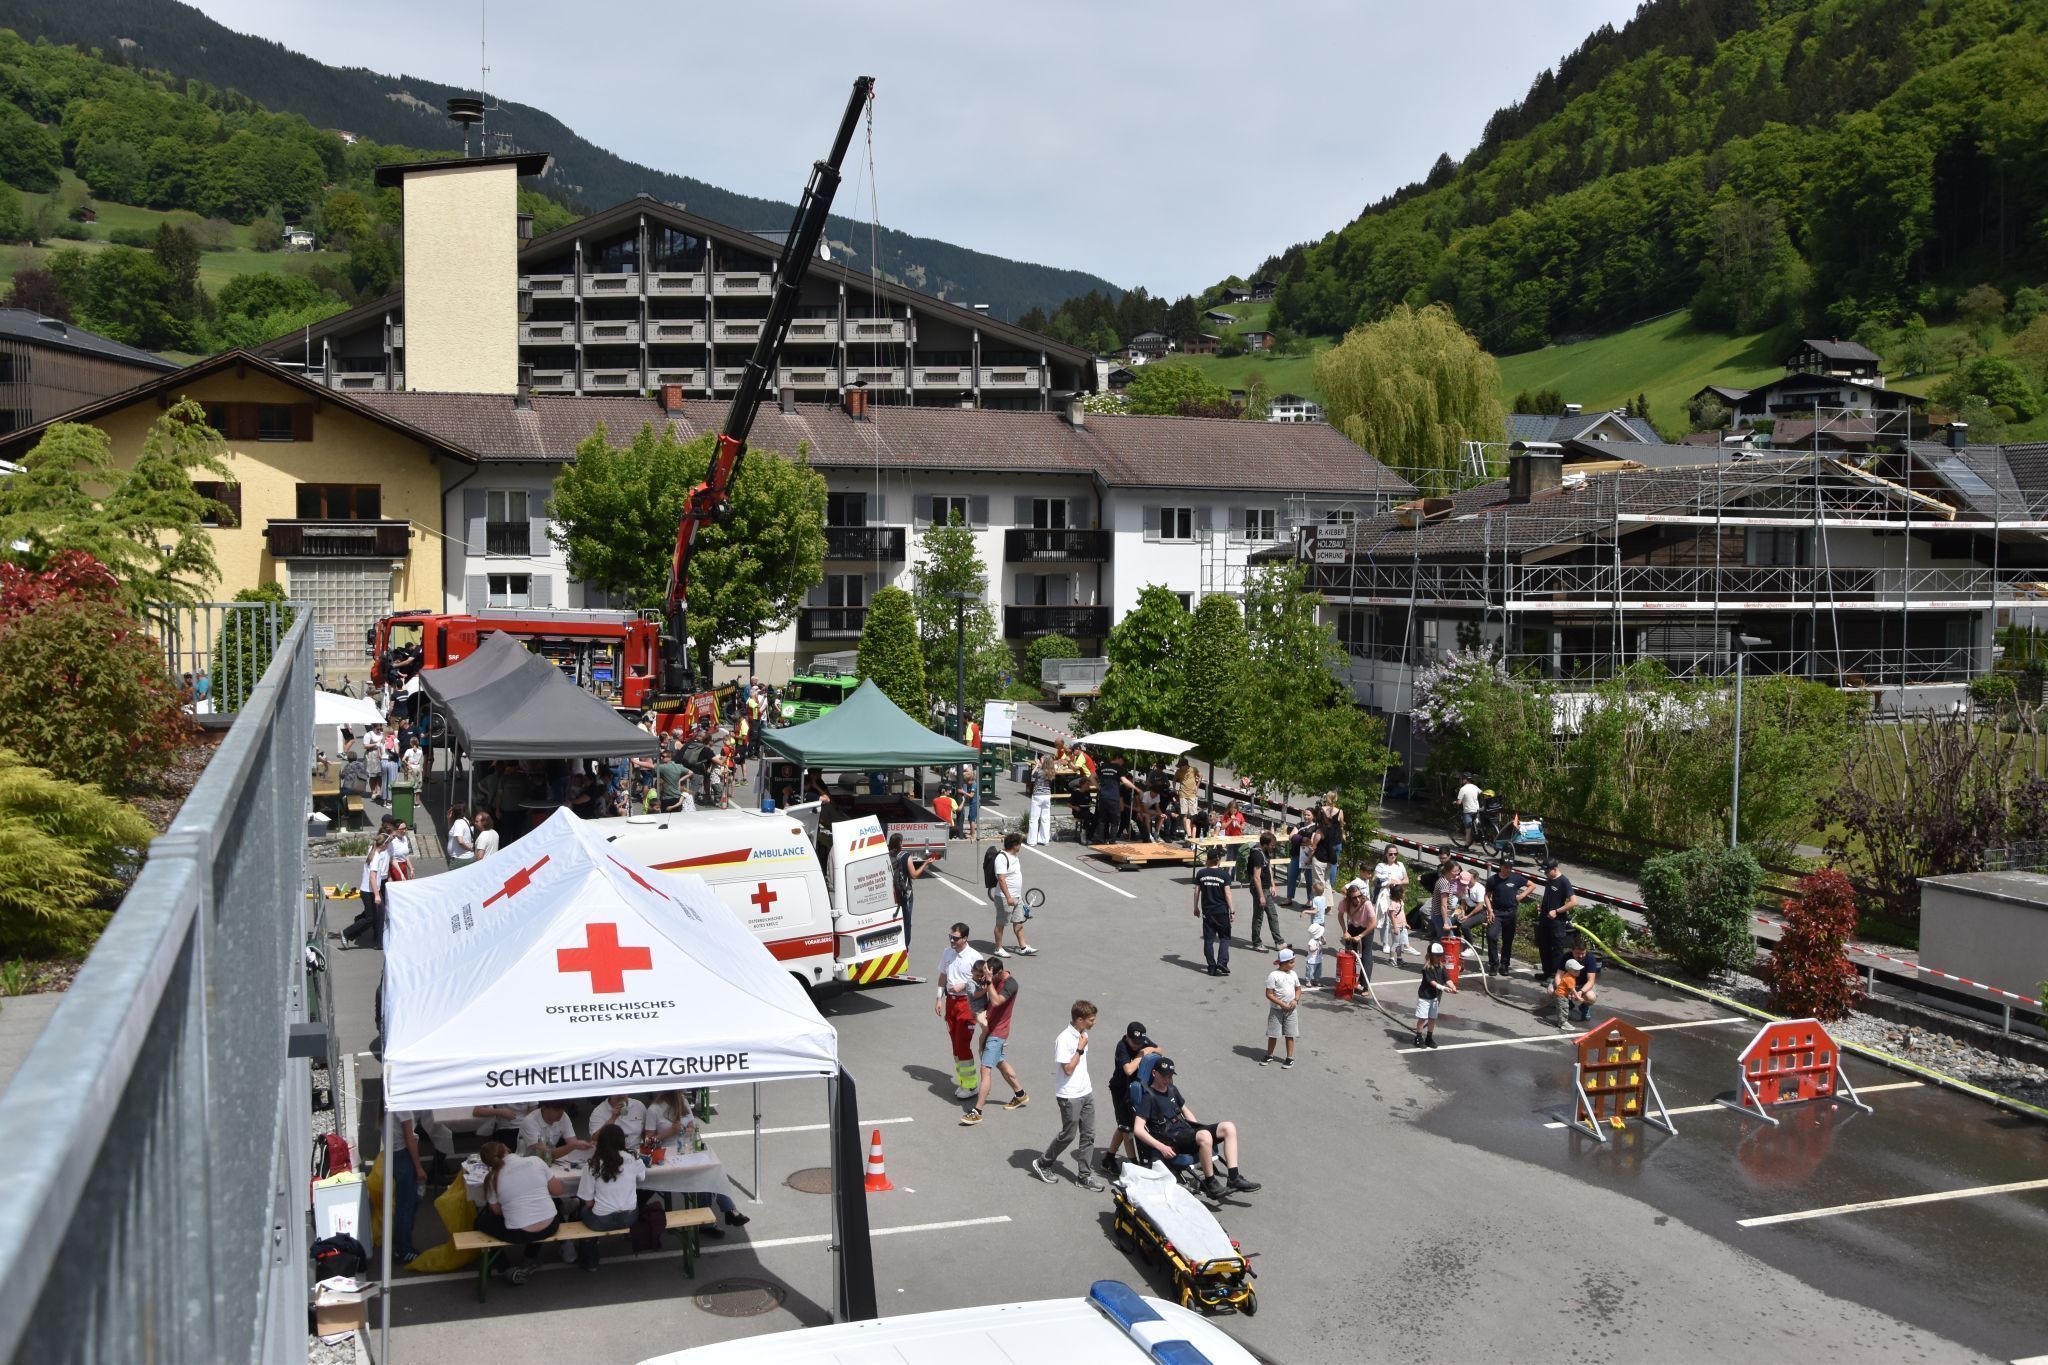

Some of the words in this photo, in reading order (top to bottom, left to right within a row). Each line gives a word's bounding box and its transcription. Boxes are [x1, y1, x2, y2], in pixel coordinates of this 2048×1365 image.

[1317, 540, 1344, 548] HOLZBAU
[753, 847, 805, 859] AMBULANCE
[805, 937, 832, 946] VORARLBERG
[546, 1000, 676, 1014] ÖSTERREICHISCHES
[569, 1013, 612, 1023] ROTES
[616, 1010, 660, 1021] KREUZ
[485, 1052, 750, 1088] SCHNELLEINSATZGRUPPE
